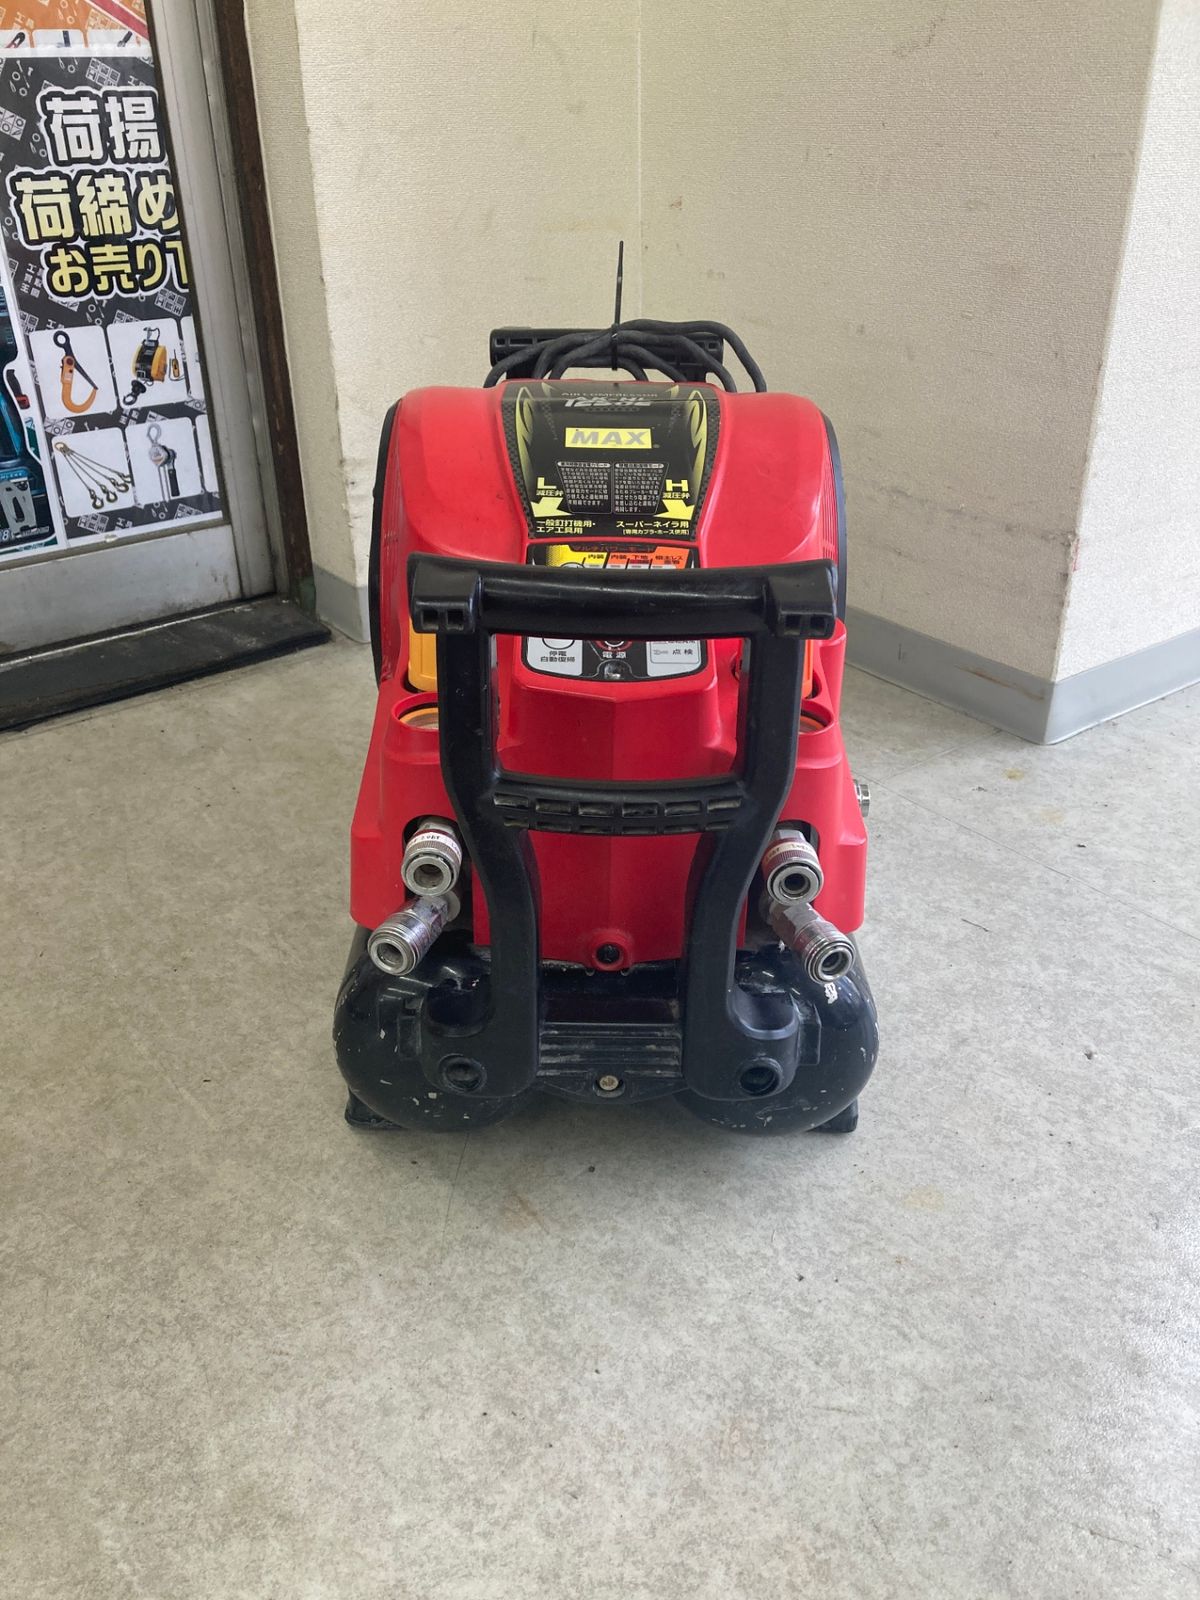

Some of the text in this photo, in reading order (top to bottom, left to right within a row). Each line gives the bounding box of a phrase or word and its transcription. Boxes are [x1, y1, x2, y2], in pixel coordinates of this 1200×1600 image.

[45, 96, 161, 161] 荷揚
[15, 173, 180, 241] 荷締め
[570, 430, 649, 445] MAX
[537, 477, 557, 489] L
[665, 479, 689, 492] H
[536, 489, 564, 497] 減圧弁
[662, 491, 691, 499] 減圧弁
[536, 526, 583, 534] エア工具用
[616, 520, 689, 529] スーパーネイラ用
